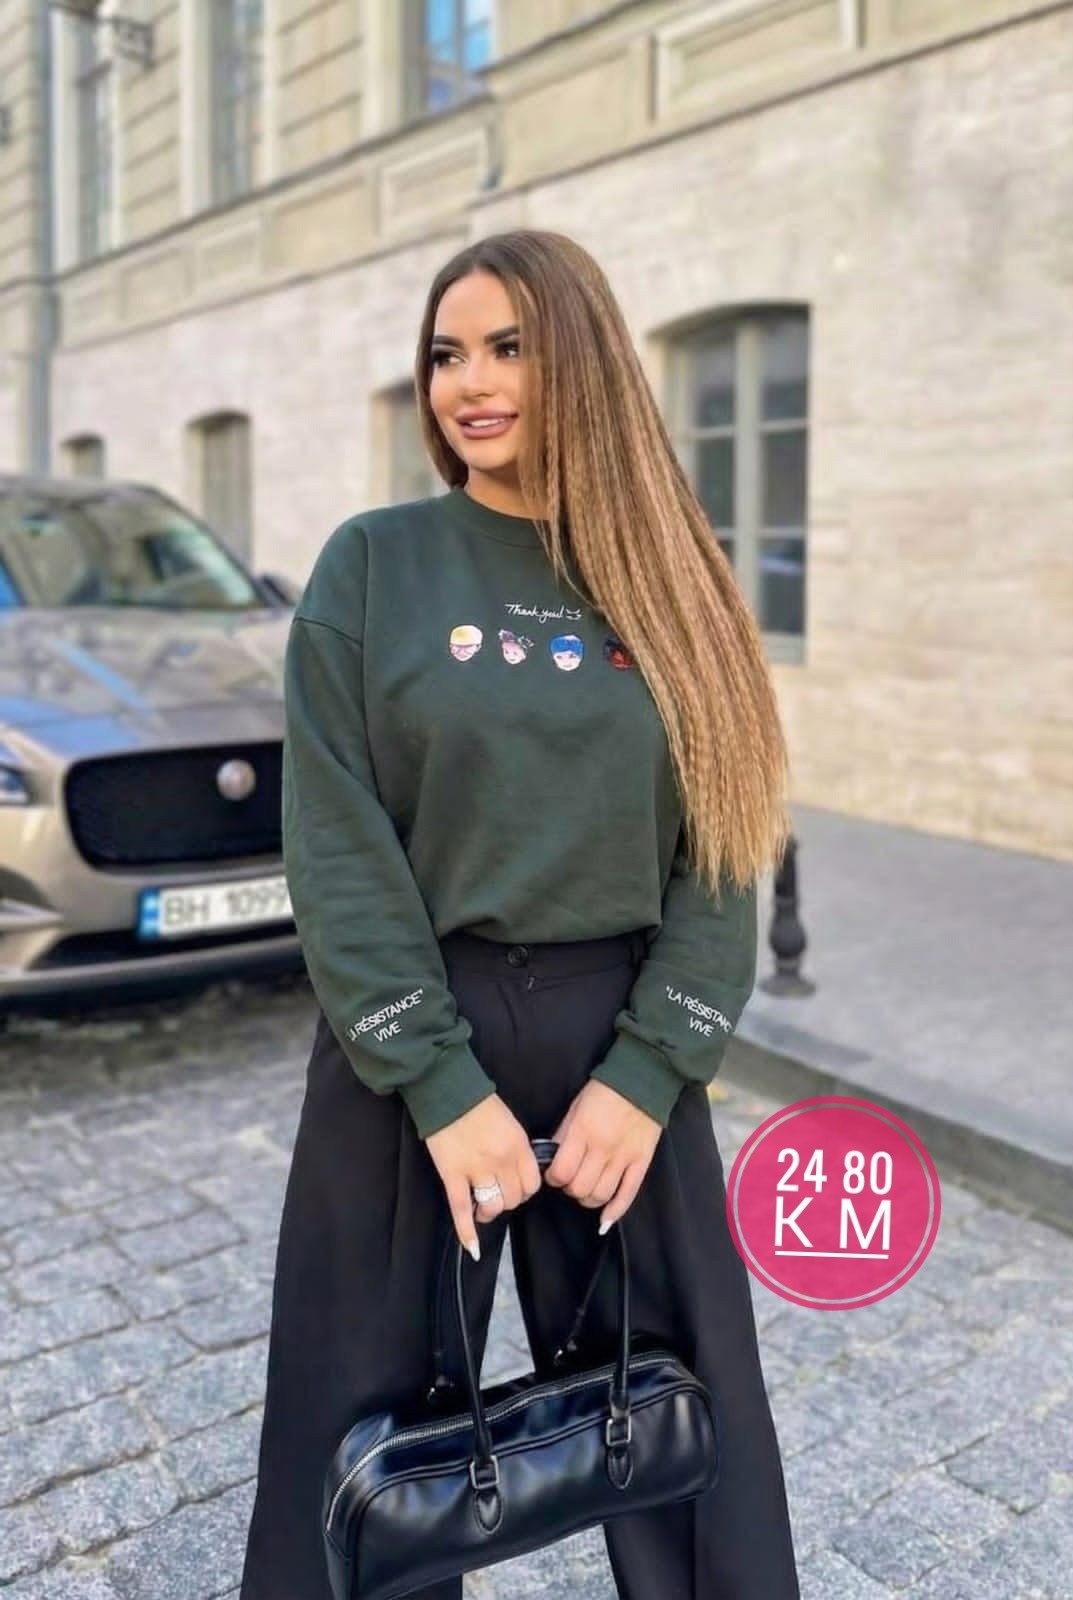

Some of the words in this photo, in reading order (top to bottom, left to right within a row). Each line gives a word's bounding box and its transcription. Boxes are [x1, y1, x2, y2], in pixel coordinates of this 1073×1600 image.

[504, 603, 537, 616] Thank
[163, 894, 211, 926] BH
[683, 996, 733, 1033] RÉSISTANC
[373, 1020, 402, 1042] VIVE
[689, 1016, 715, 1038] VIVE
